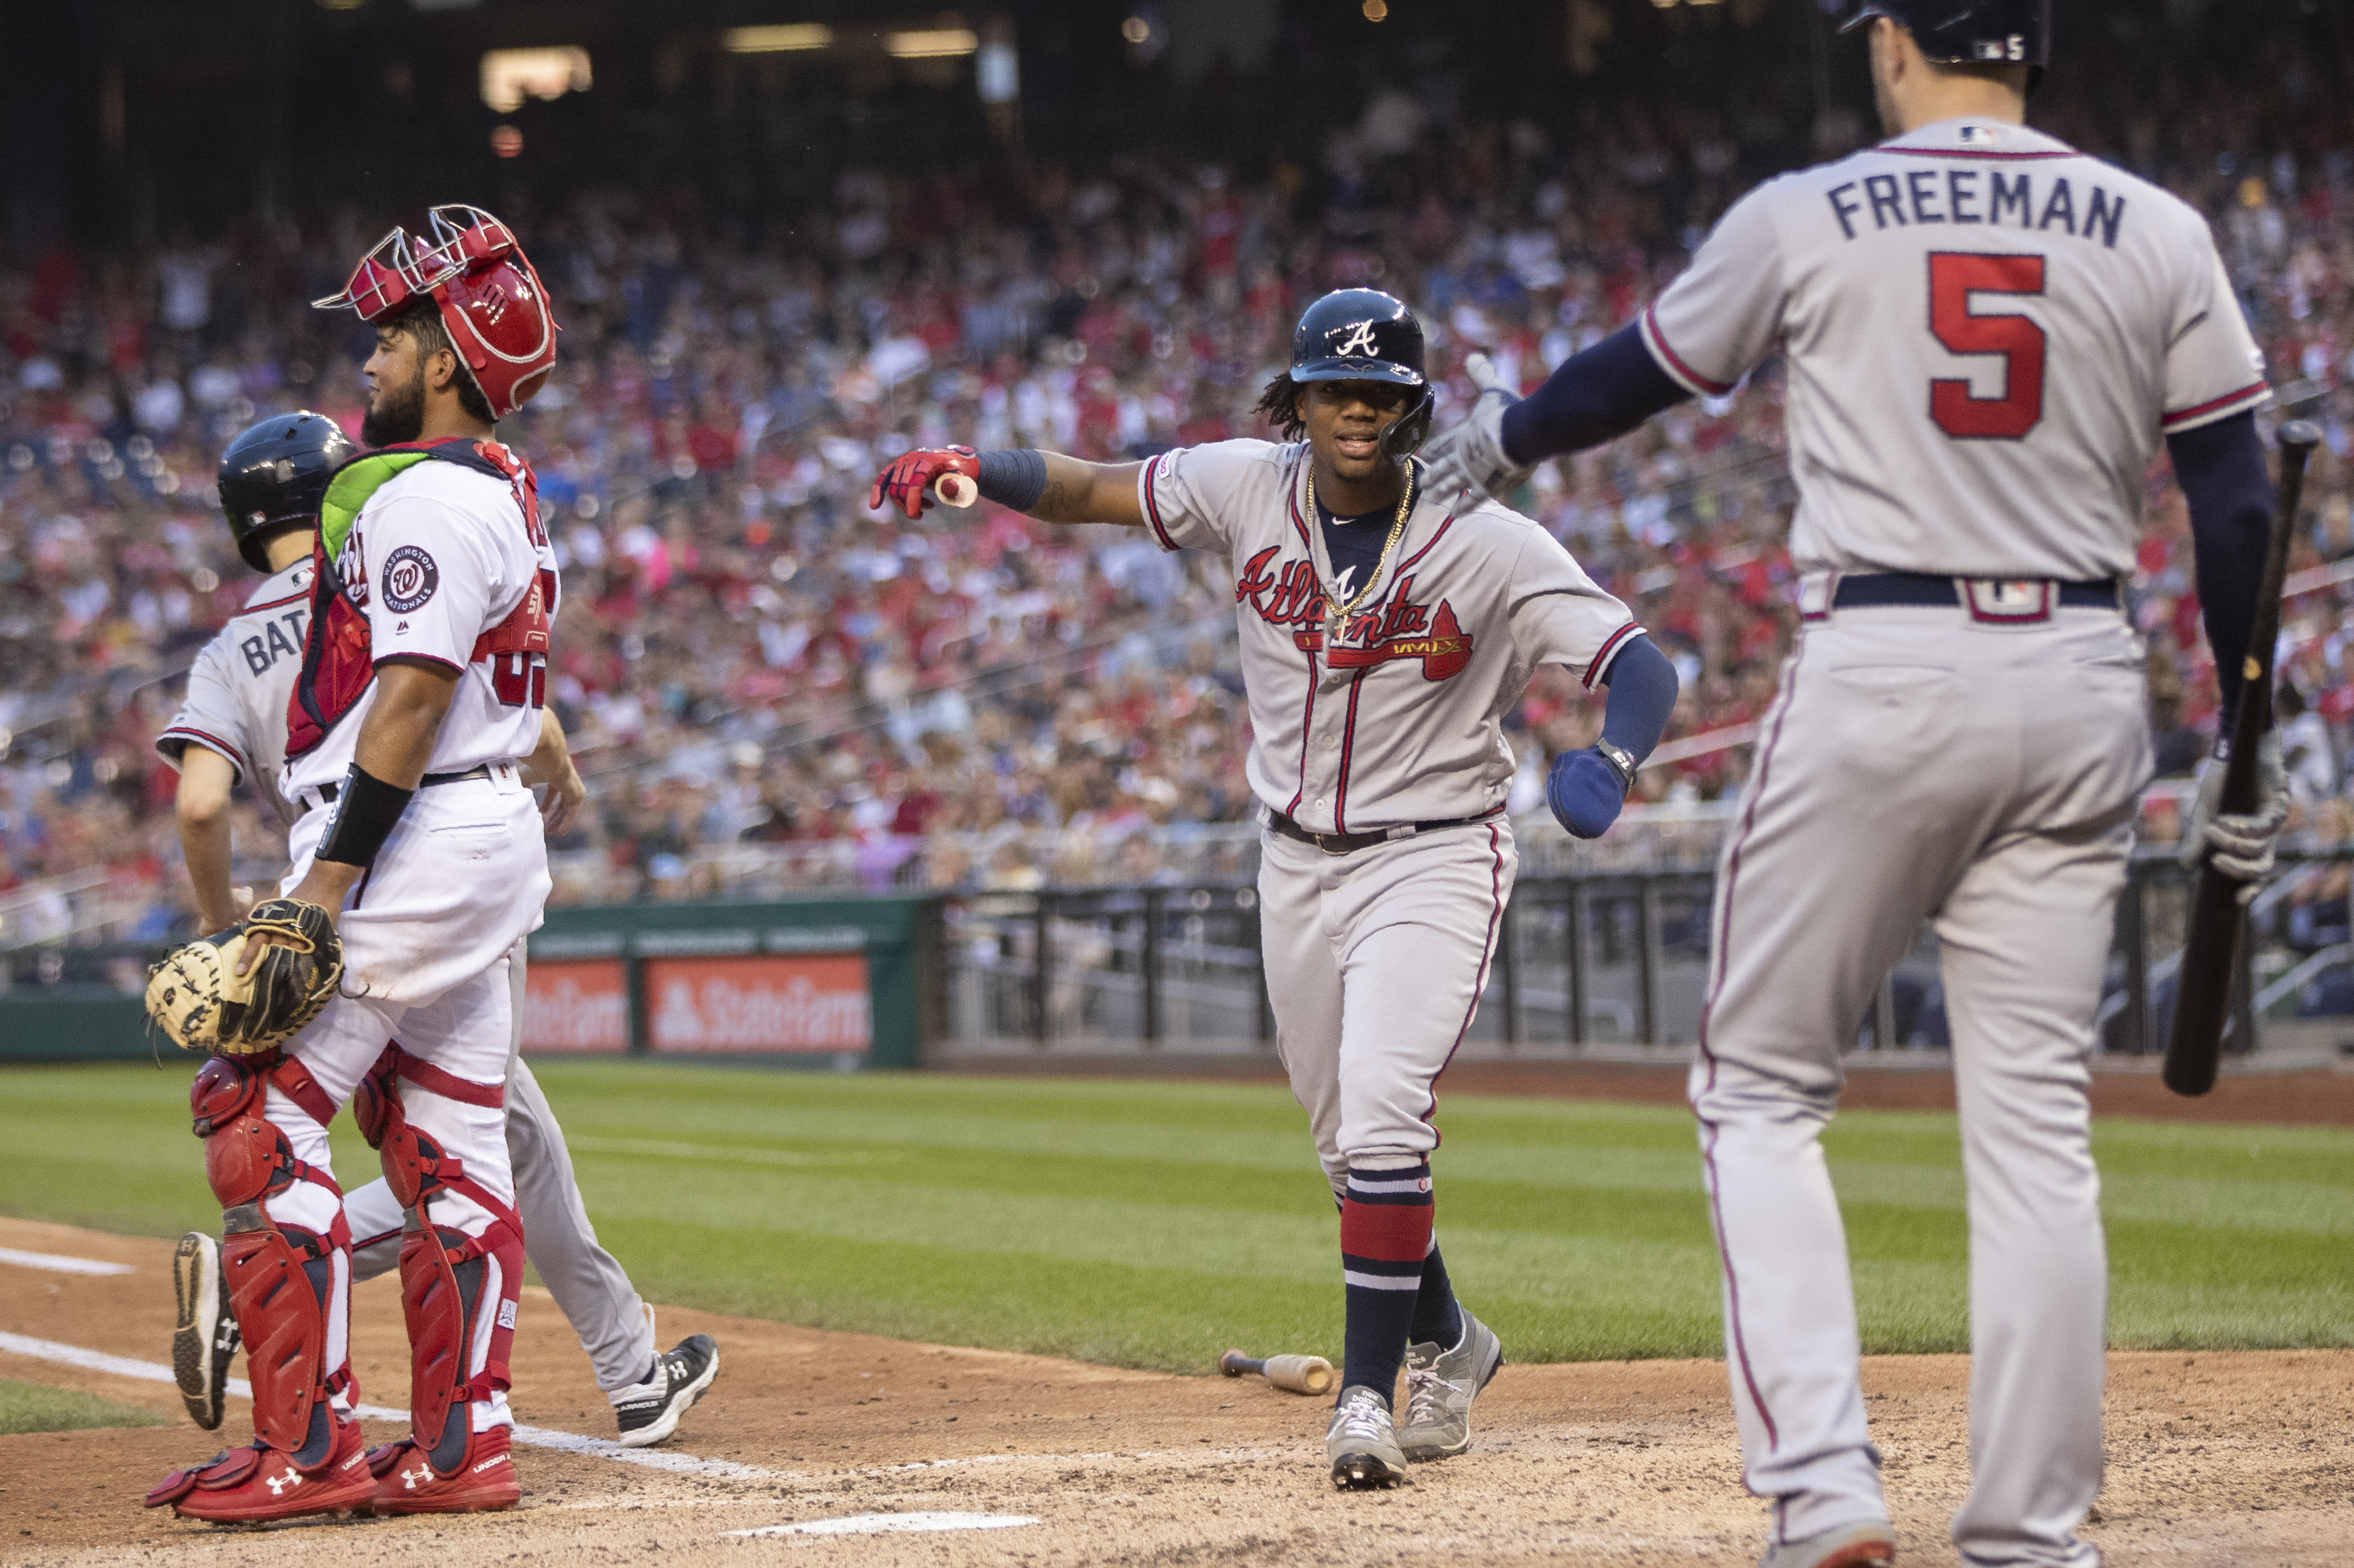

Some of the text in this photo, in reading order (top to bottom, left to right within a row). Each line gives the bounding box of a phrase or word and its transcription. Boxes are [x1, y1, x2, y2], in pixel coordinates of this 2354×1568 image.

[2008, 34, 2025, 60] 5
[1826, 171, 2126, 249] FREEMAN
[1336, 318, 1379, 356] A
[1927, 251, 2046, 440] 5
[384, 548, 434, 576] WASHINGTON
[394, 564, 419, 595] W
[1235, 544, 1431, 643] Atlanta
[385, 588, 431, 611] NATIONALS
[1362, 1389, 1379, 1401] new
[473, 1454, 508, 1474] UNDER
